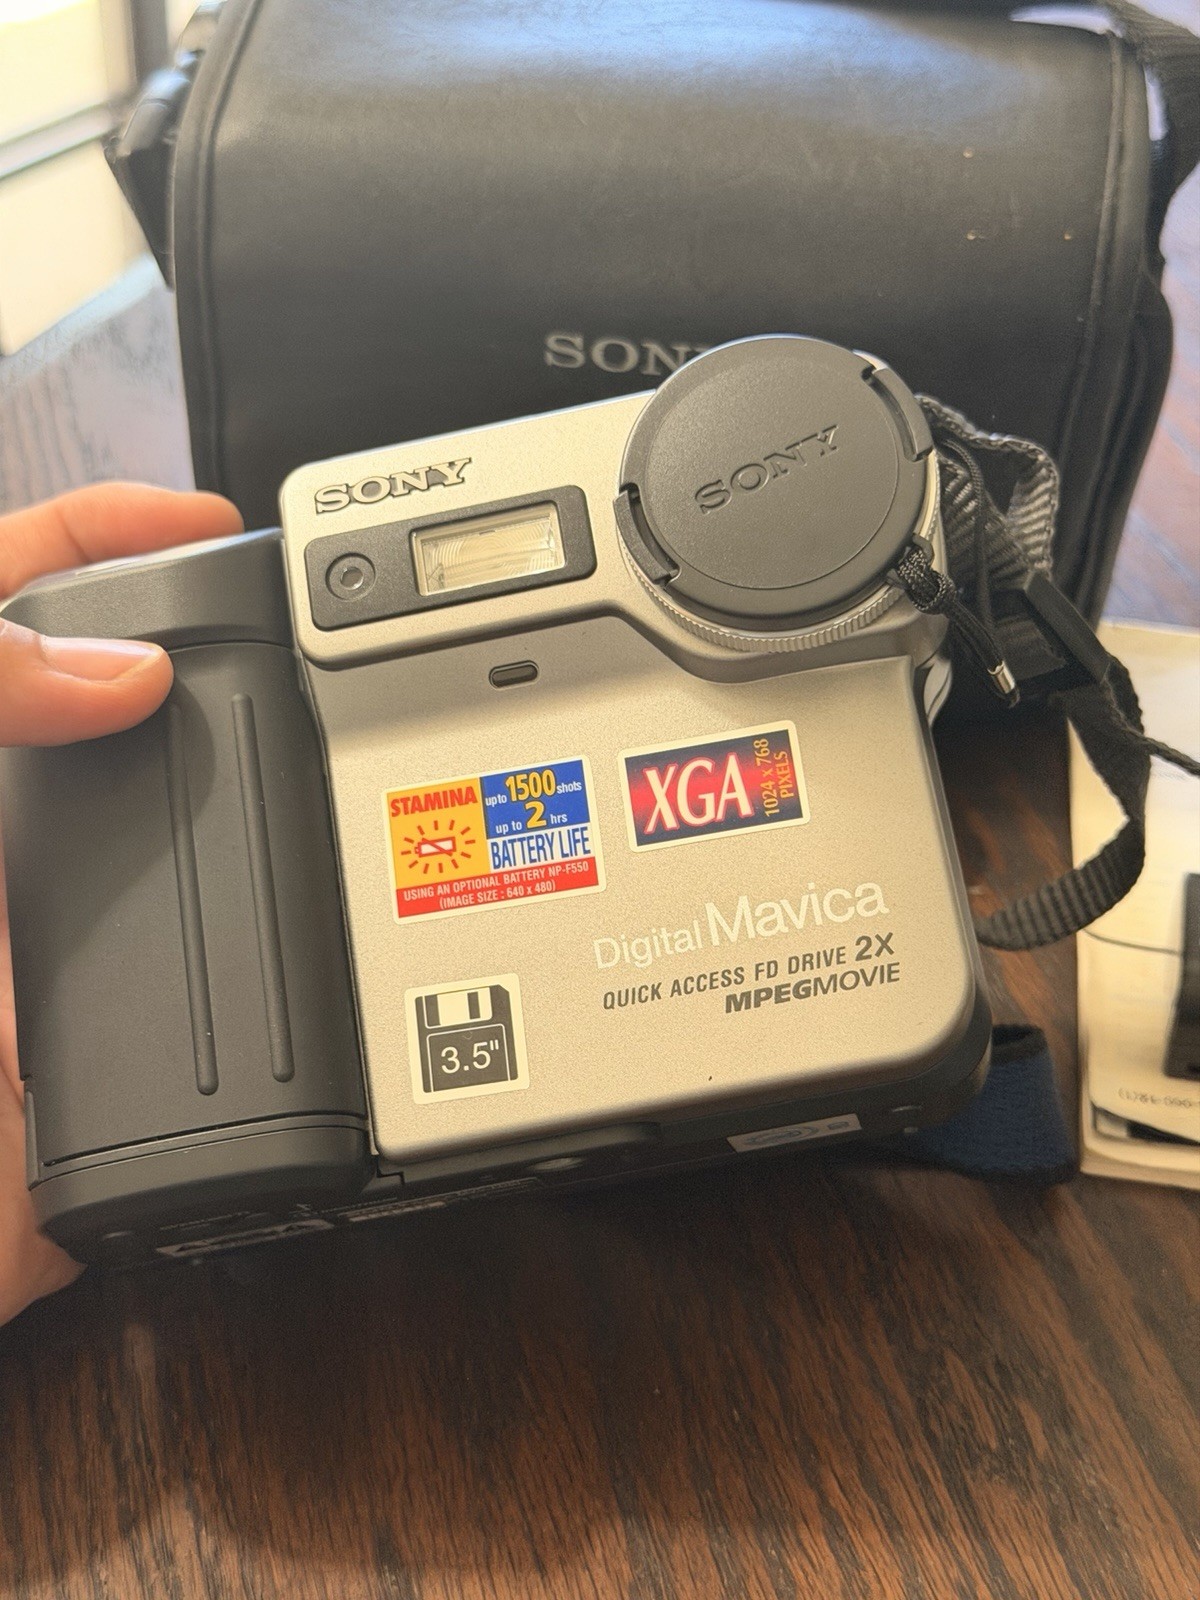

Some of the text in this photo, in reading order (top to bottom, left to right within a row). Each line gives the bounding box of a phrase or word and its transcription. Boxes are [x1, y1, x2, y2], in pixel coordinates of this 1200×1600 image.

[544, 331, 709, 376] SON
[314, 457, 472, 515] SONY
[694, 425, 839, 514] SONY
[753, 737, 771, 766] 768
[505, 769, 556, 801] 1500
[556, 781, 582, 794] shots
[643, 752, 754, 834] XGA
[774, 751, 795, 799] PIXELS
[390, 786, 478, 817] STAMINA
[495, 800, 568, 835] up to 2 hrs
[760, 781, 780, 817] 1024
[490, 826, 591, 870] BATTERY LIFE
[403, 861, 589, 901] USING AN OPTIONAL BATTERY NP-F550
[439, 893, 474, 910] (IMAGE
[477, 890, 498, 905] SIZE
[506, 886, 524, 898] 640
[534, 880, 557, 894] 480)
[592, 881, 890, 969] Digital Mavica
[603, 931, 895, 1010] QUICK ACCESS FD DRIVE 2X
[440, 1039, 499, 1074] 3.5"
